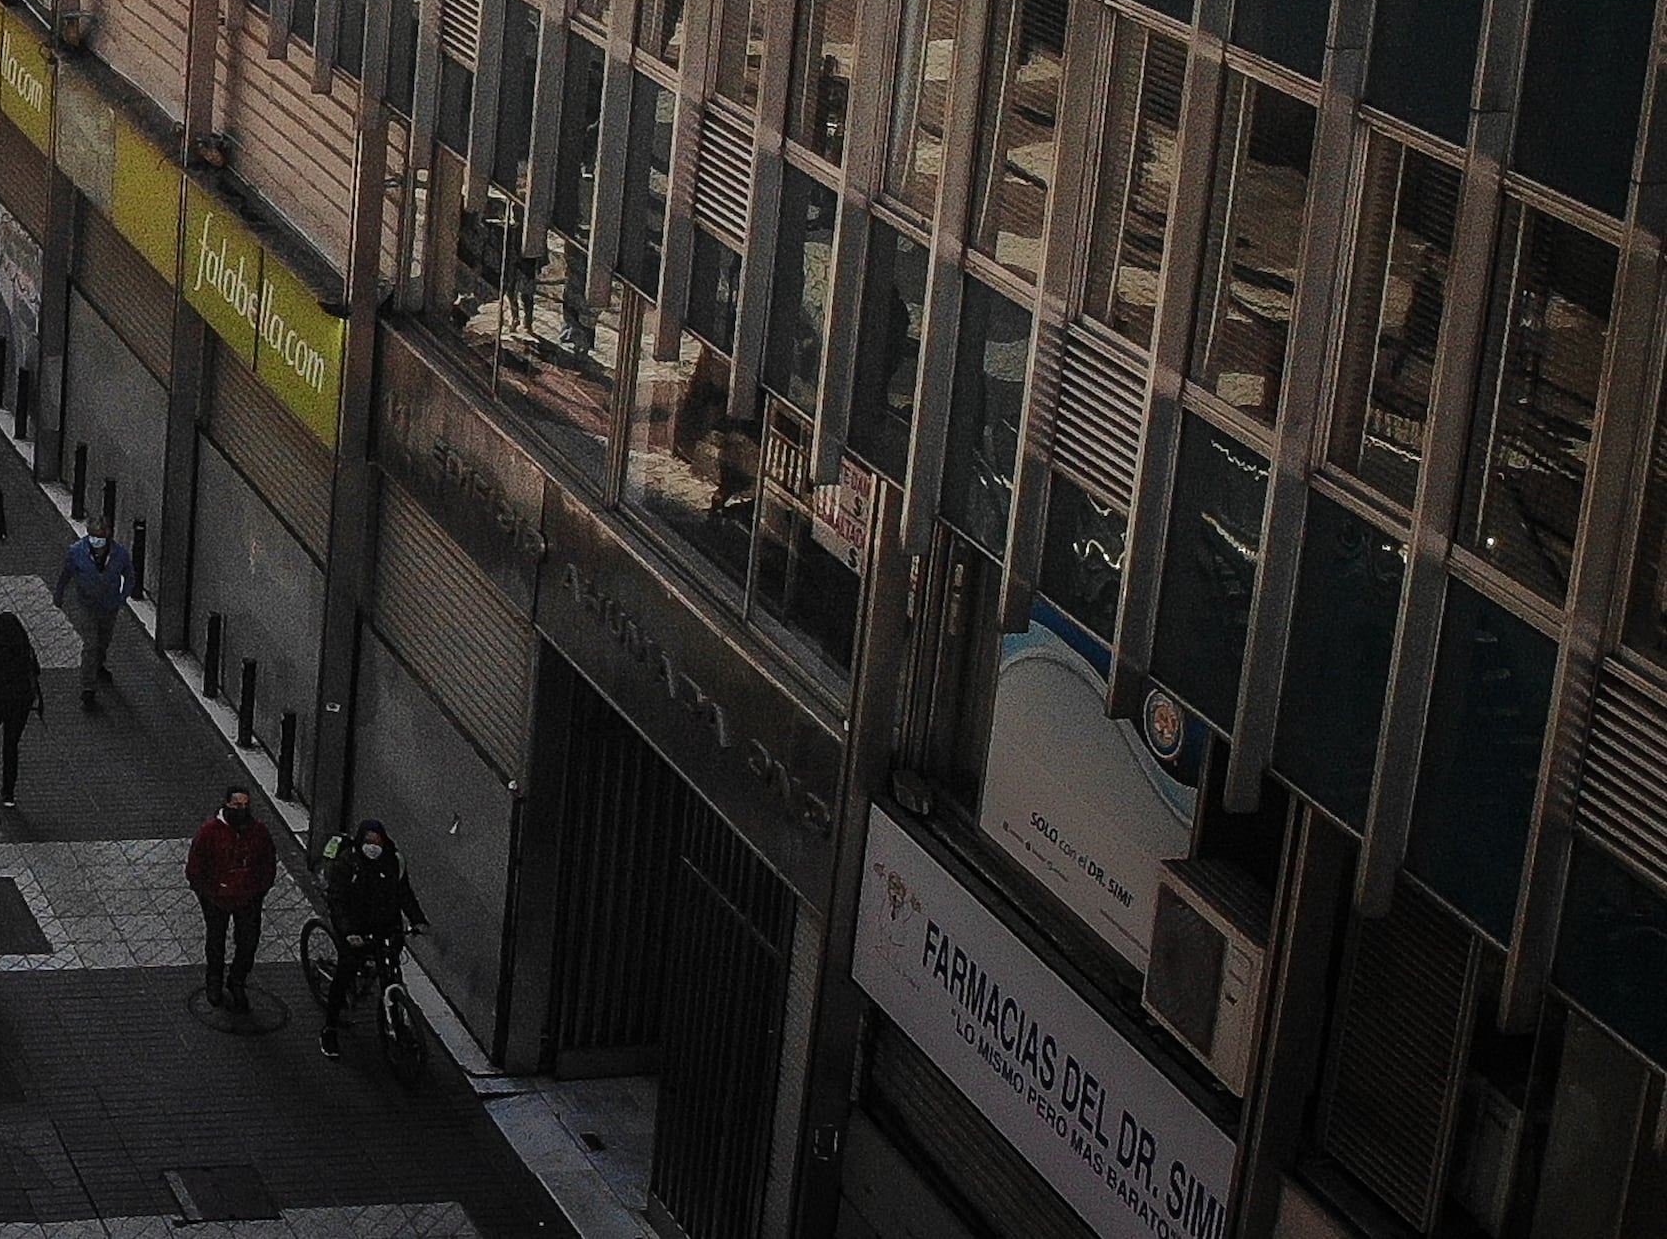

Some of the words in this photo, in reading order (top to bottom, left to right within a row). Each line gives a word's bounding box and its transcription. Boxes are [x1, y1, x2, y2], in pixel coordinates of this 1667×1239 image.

[193, 211, 325, 393] falabella.com
[1030, 811, 1058, 843] SOLO
[1059, 840, 1077, 859] con
[1078, 855, 1088, 870] el
[1088, 861, 1106, 888] DR.
[922, 918, 1057, 1091] FARMACIAS
[1061, 1055, 1110, 1149] DEL
[1118, 1109, 1159, 1199] DR.
[977, 1038, 1025, 1095] MISMO
[1027, 1086, 1067, 1139] PERO
[1070, 1128, 1104, 1178] MAS
